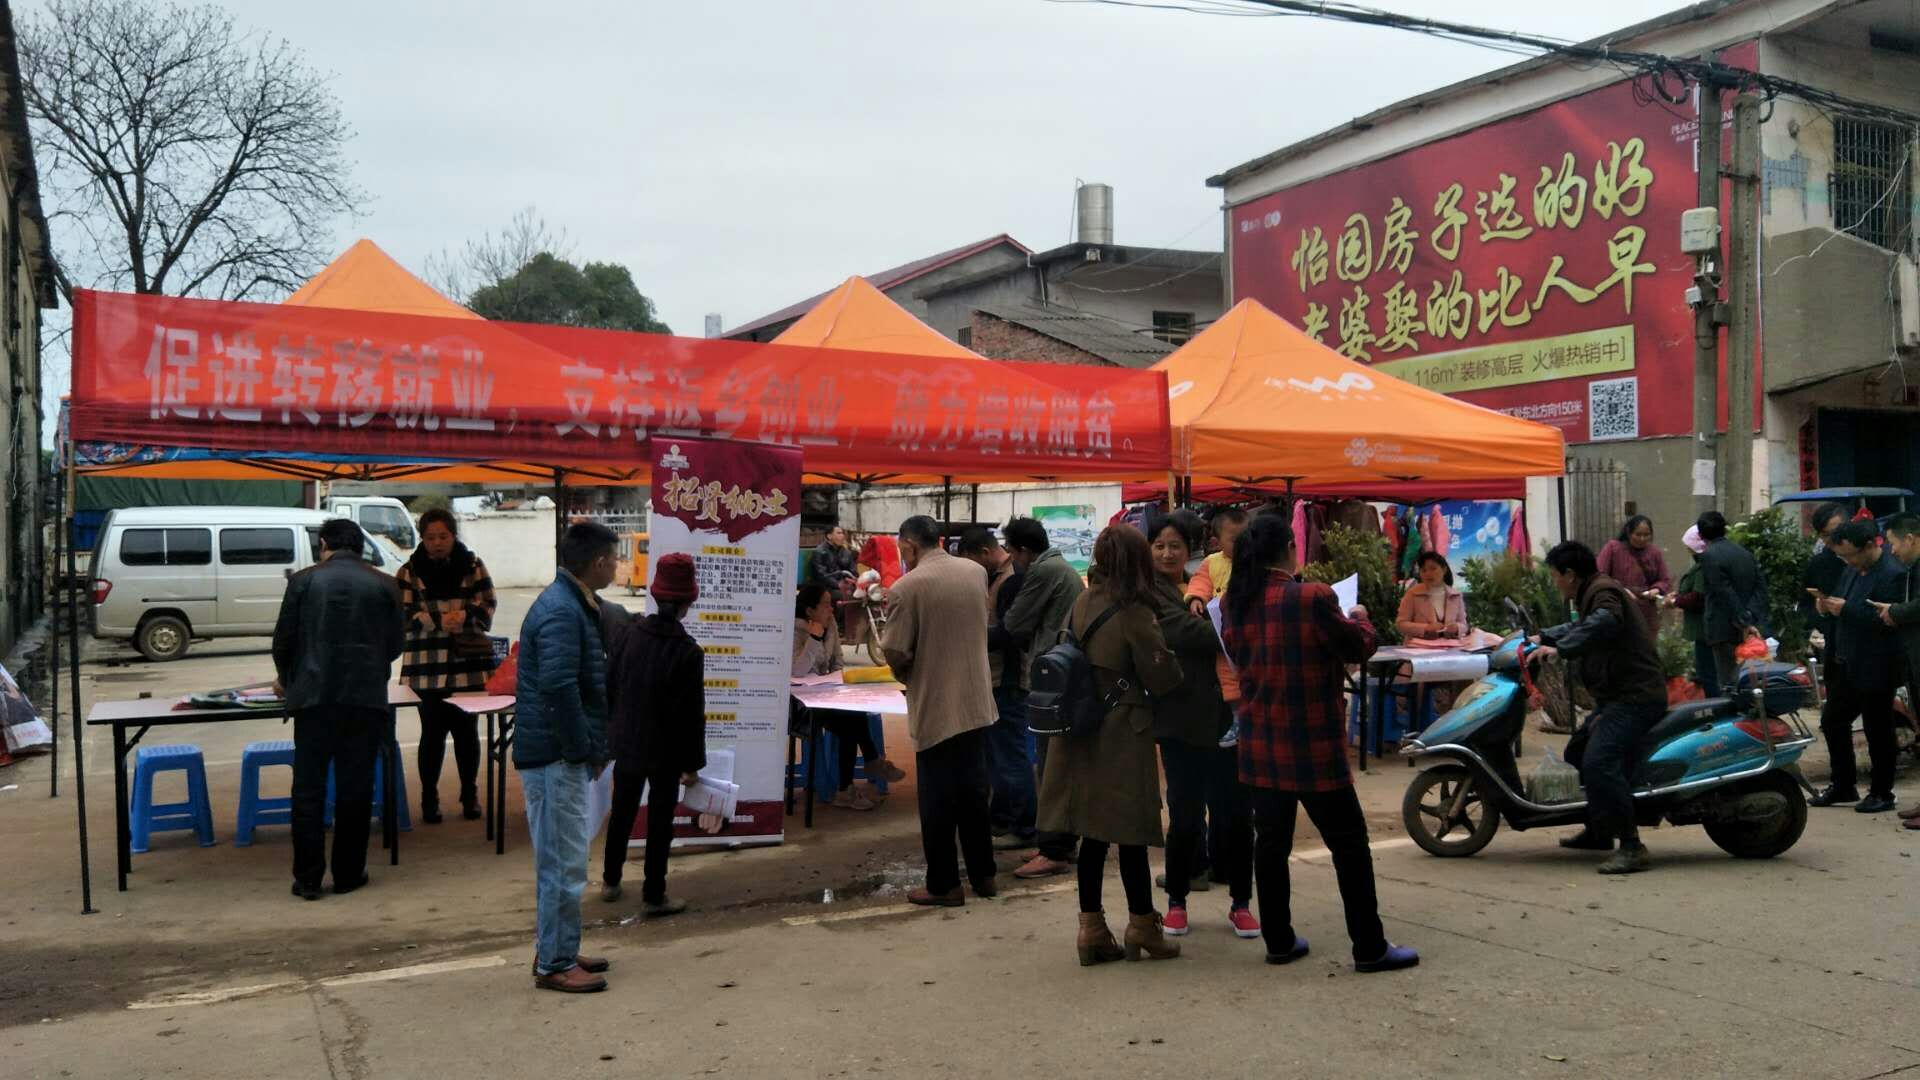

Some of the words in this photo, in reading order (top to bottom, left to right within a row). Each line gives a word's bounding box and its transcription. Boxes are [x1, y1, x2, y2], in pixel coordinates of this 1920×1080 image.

[1292, 138, 1654, 293] 怡园房子选的好
[662, 471, 788, 524] 招贤纳士
